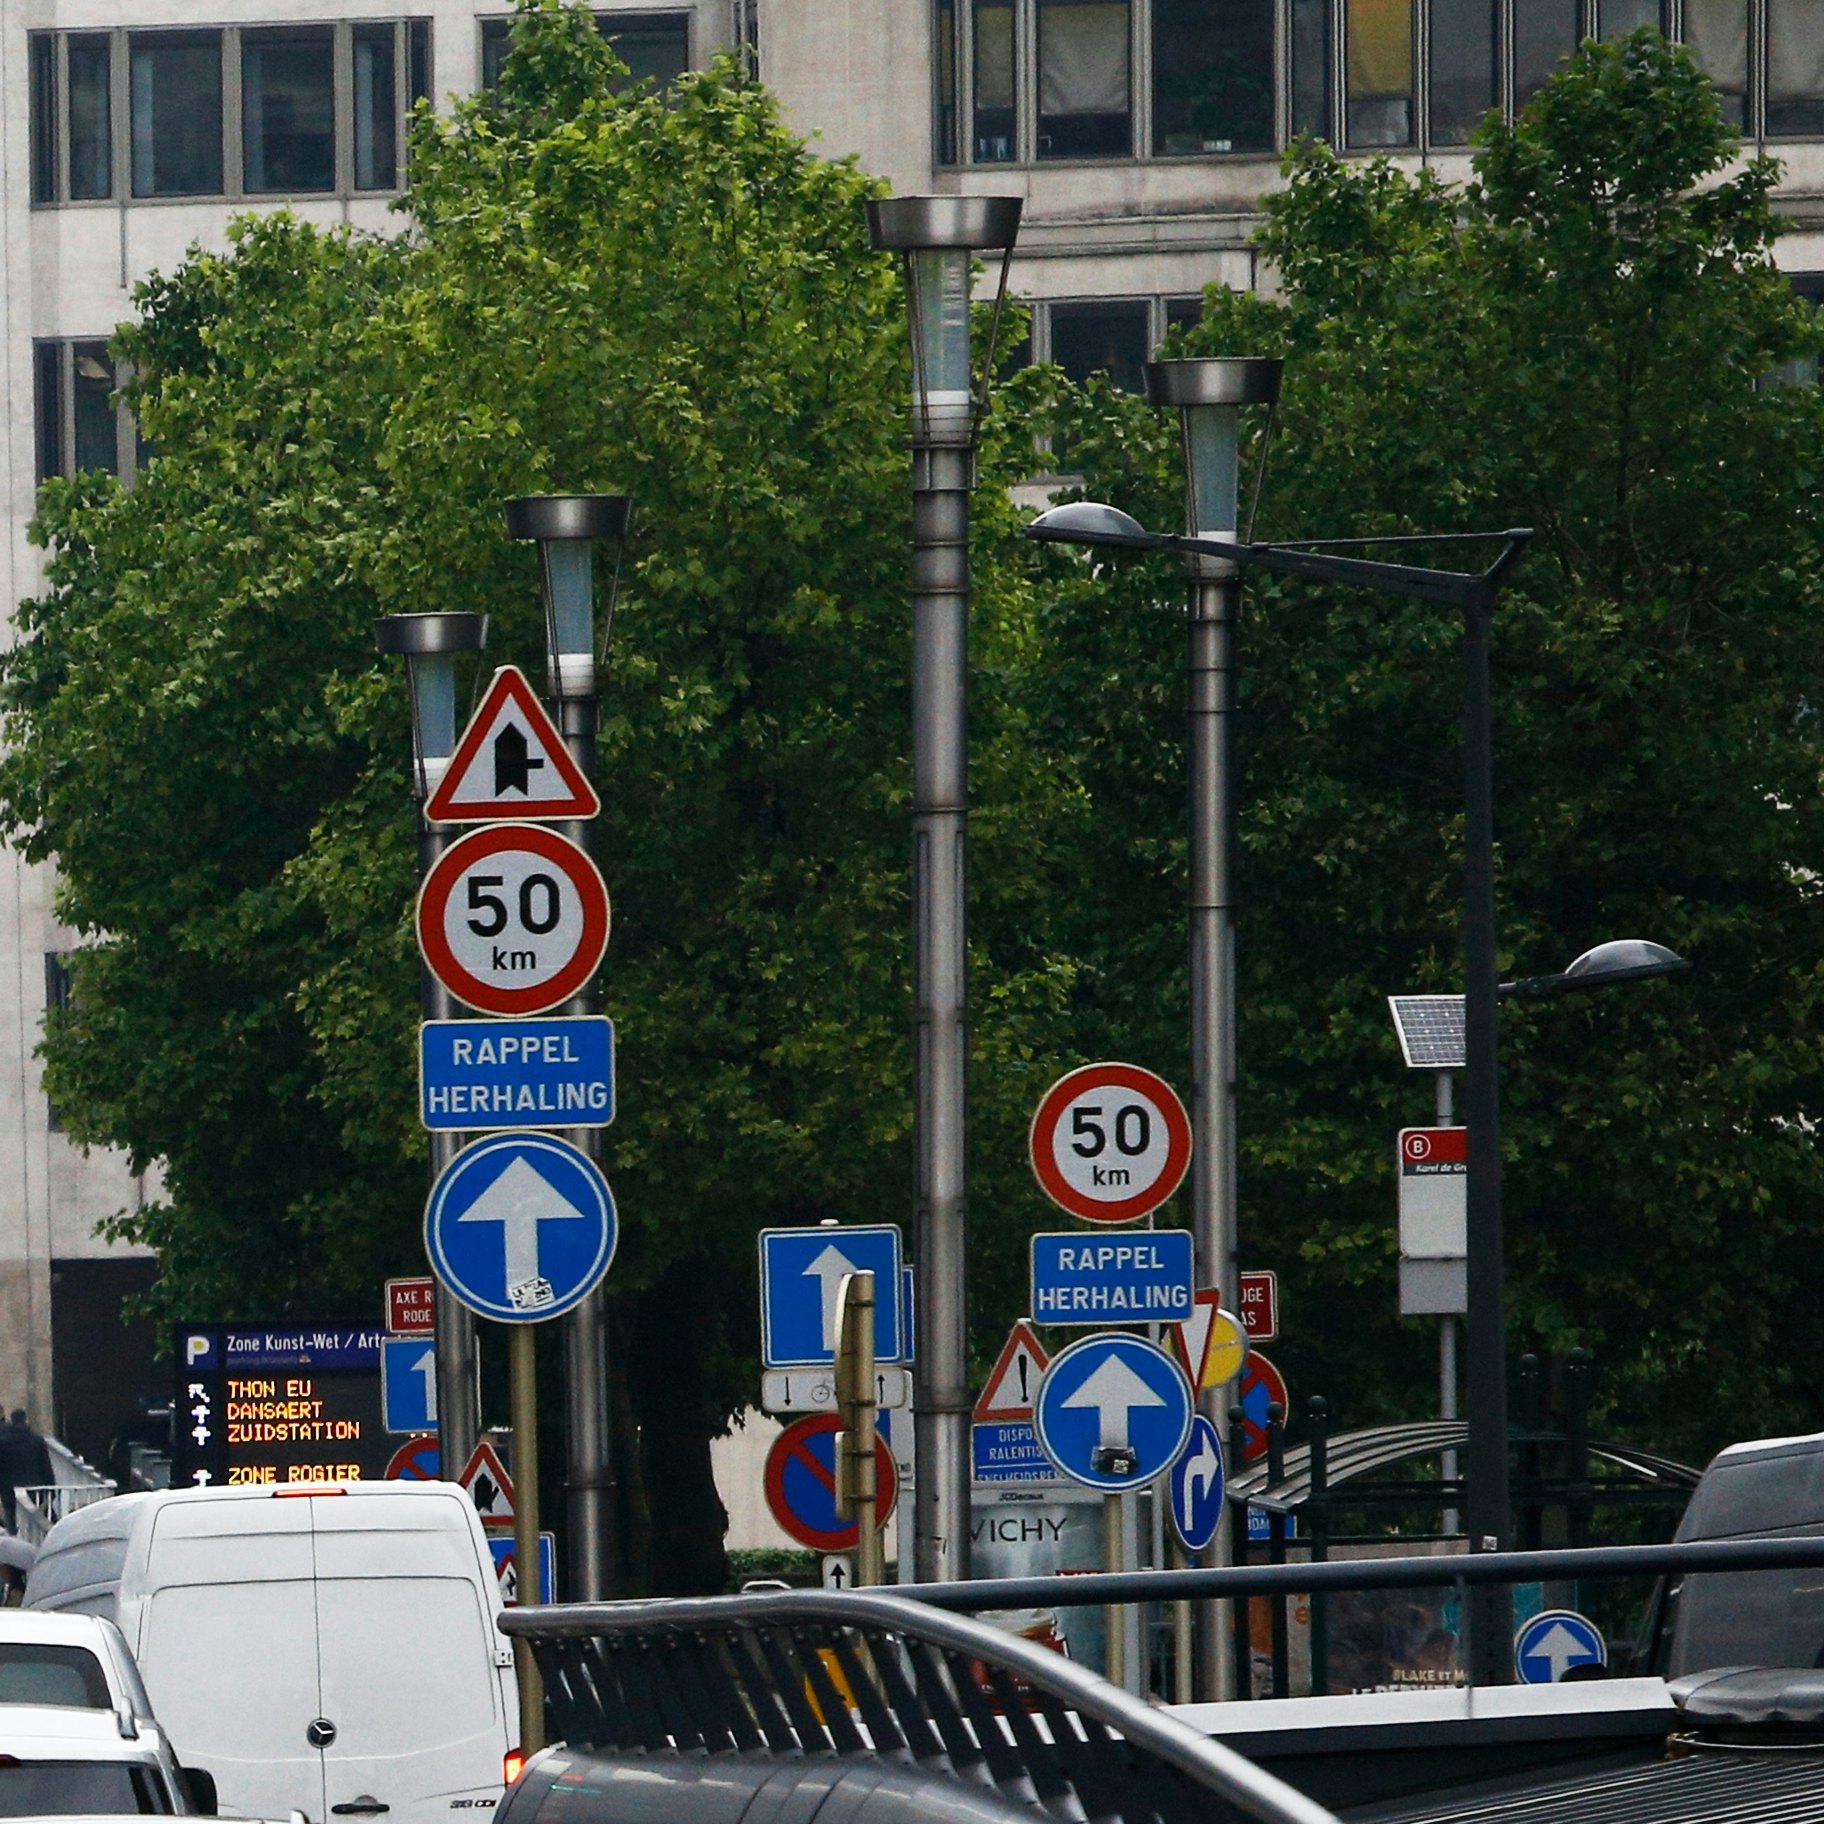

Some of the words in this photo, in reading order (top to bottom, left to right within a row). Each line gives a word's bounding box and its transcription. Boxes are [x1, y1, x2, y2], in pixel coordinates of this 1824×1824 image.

[467, 873, 560, 937] 50
[492, 946, 536, 971] km
[453, 1036, 580, 1066] RAPPEL
[428, 1081, 608, 1114] HERHALING
[1072, 1105, 1151, 1158] 50
[1413, 1140, 1424, 1154] B
[1092, 1165, 1130, 1187] km
[1415, 1163, 1439, 1173] Karel
[1058, 1246, 1165, 1271] RAPPEL
[396, 1290, 418, 1304] AXE
[1037, 1284, 1189, 1311] HERHALING
[403, 1309, 432, 1323] RODE
[186, 1336, 210, 1365] P
[226, 1335, 261, 1352] Zone
[265, 1333, 340, 1350] Kunst-Wet
[227, 1380, 275, 1399] THON
[287, 1379, 311, 1397] EU
[227, 1401, 322, 1421] DANSAERT
[227, 1422, 361, 1443] ZUIDSTATION
[998, 1428, 1033, 1442] DISPO
[989, 1445, 1042, 1460] RALENTIS
[228, 1466, 277, 1484] ZONE
[288, 1464, 361, 1483] ROGIER
[1392, 1669, 1436, 1681] BLAKE
